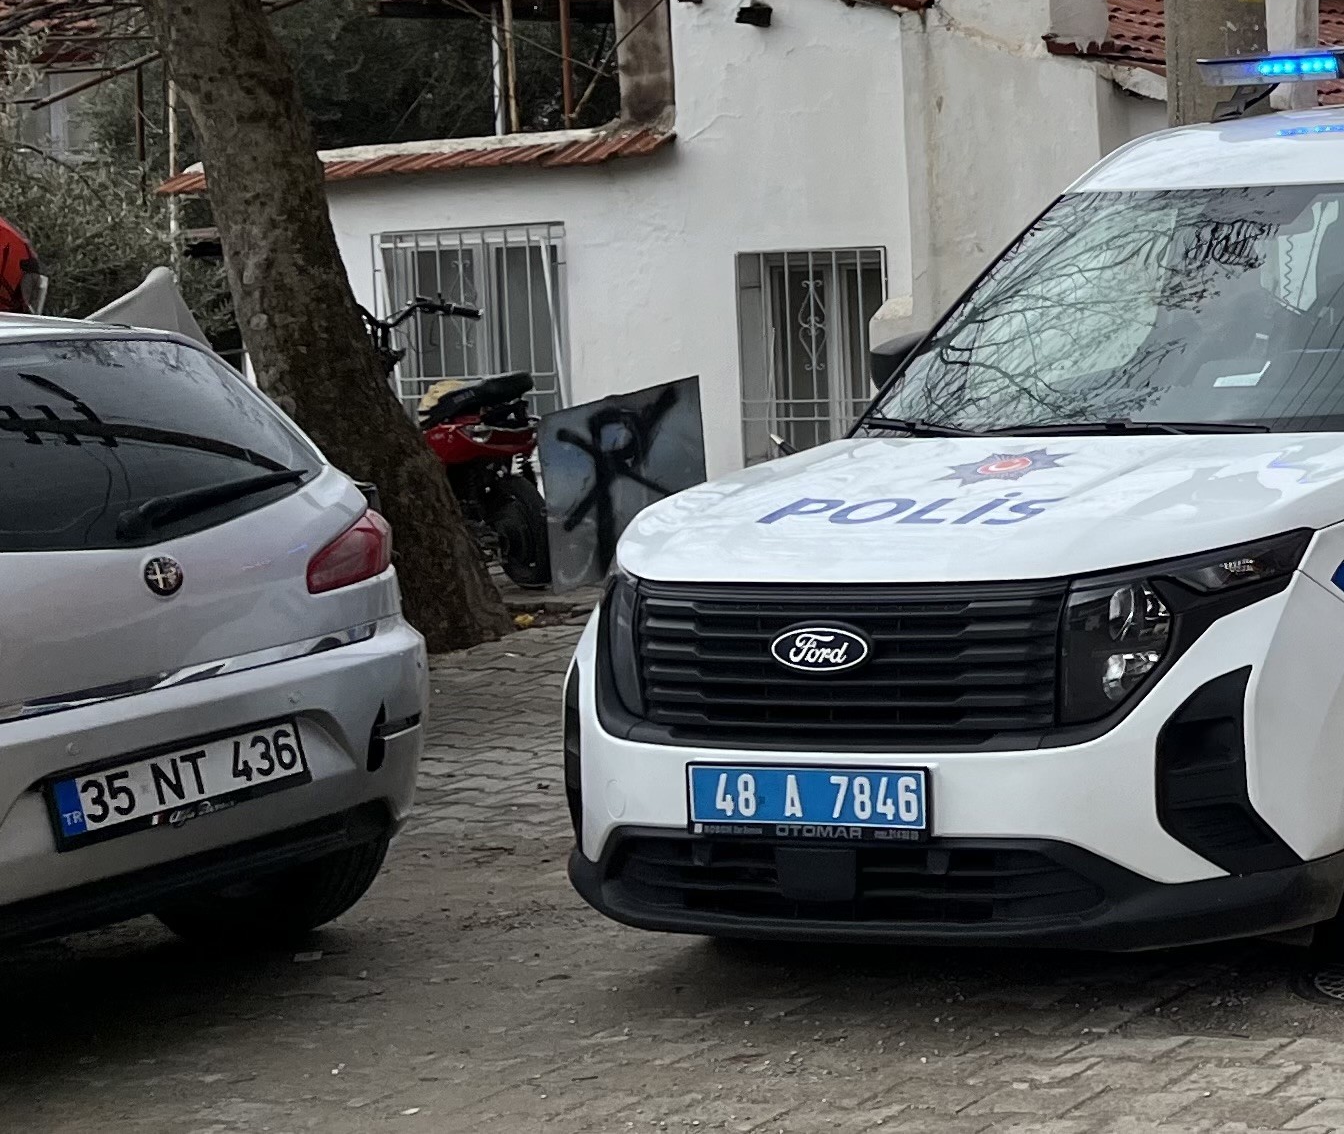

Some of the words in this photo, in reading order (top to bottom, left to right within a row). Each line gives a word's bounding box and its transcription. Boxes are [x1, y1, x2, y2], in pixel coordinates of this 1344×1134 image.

[756, 491, 1065, 526] POLİS
[788, 633, 848, 665] Ford
[80, 770, 136, 824] 35
[149, 749, 207, 806] NT
[232, 729, 298, 782] 436
[715, 773, 757, 817] 48
[784, 774, 803, 818] A
[829, 775, 920, 823] 7846
[64, 811, 83, 827] TR
[775, 824, 863, 840] OTOMAR
